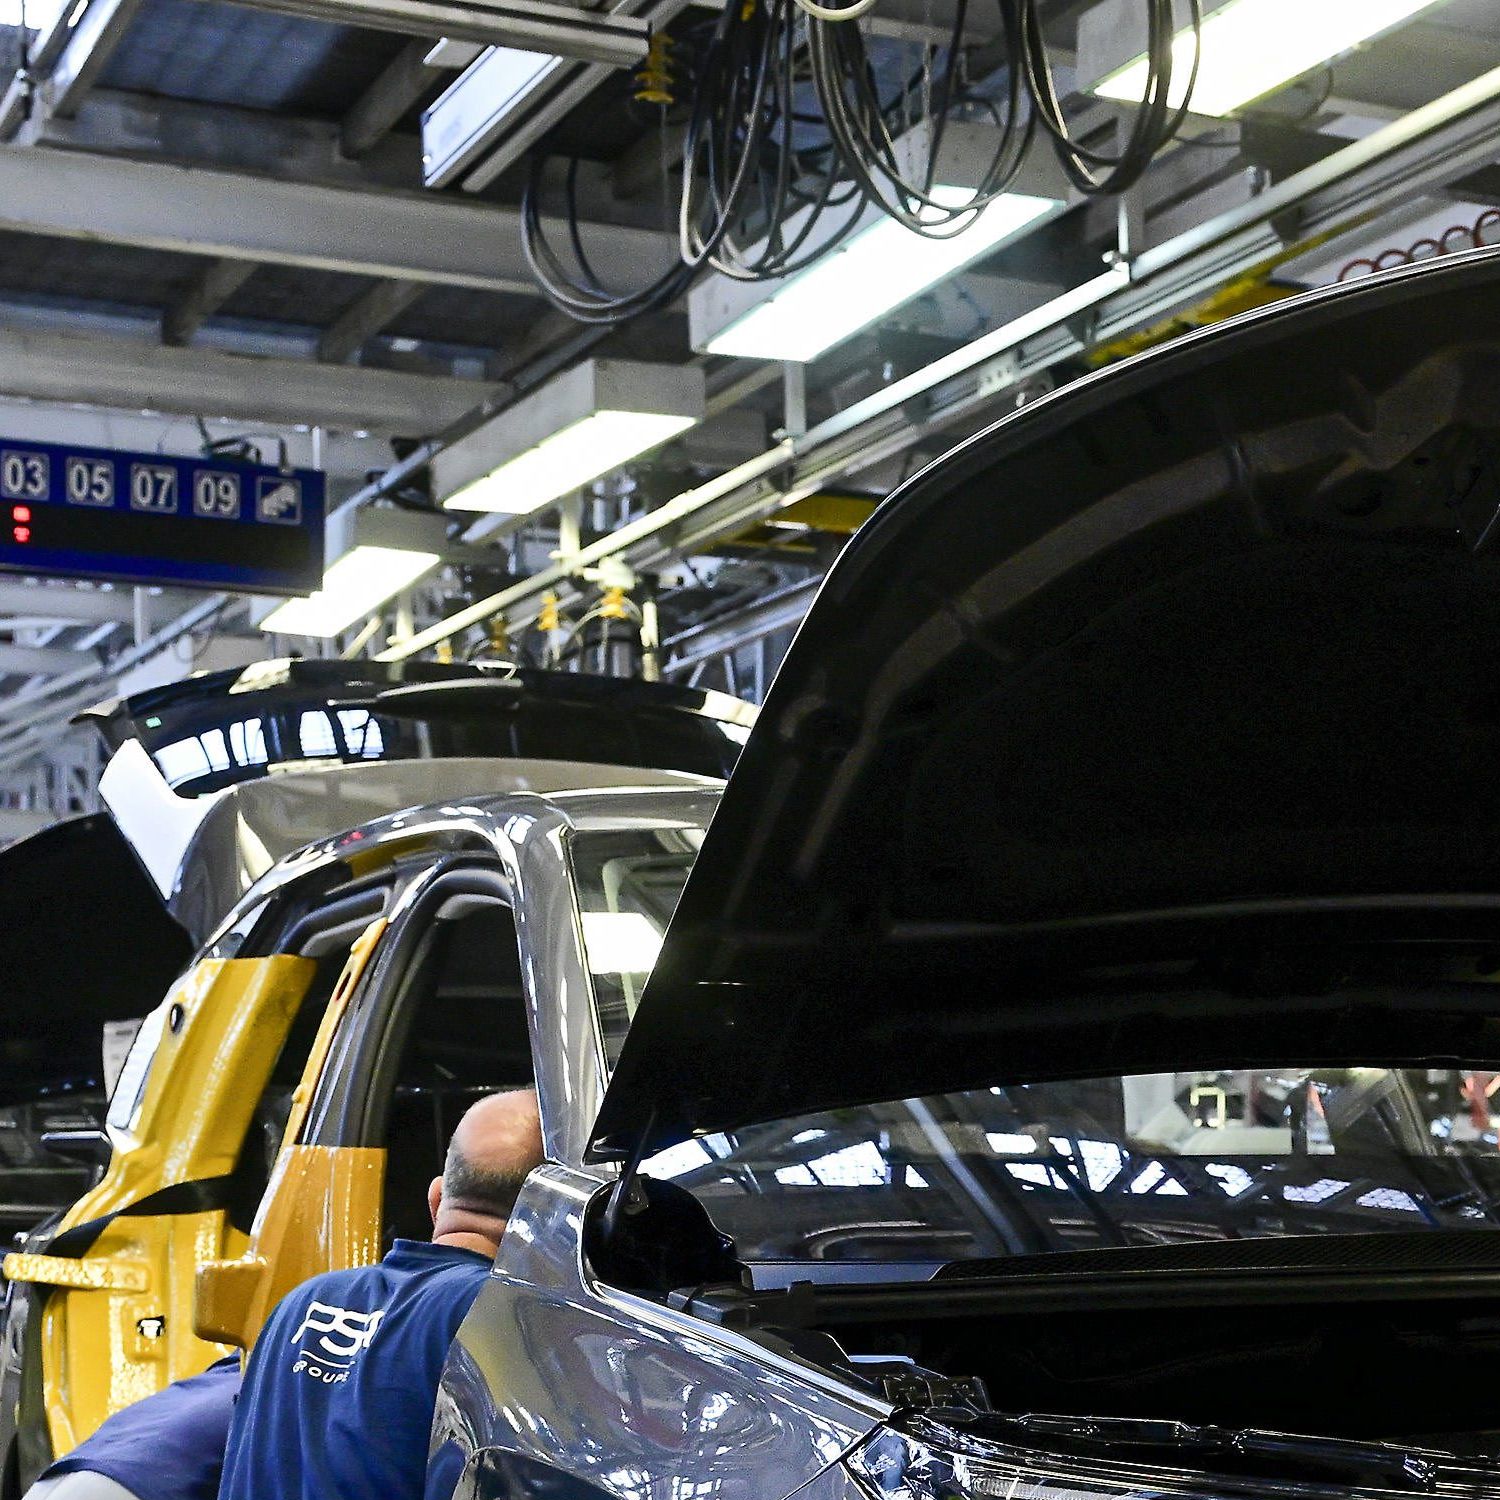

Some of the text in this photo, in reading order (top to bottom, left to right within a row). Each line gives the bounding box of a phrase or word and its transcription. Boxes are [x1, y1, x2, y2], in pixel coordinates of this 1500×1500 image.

[4, 457, 238, 514] 03 05 07 09
[293, 1360, 350, 1384] GROUPE
